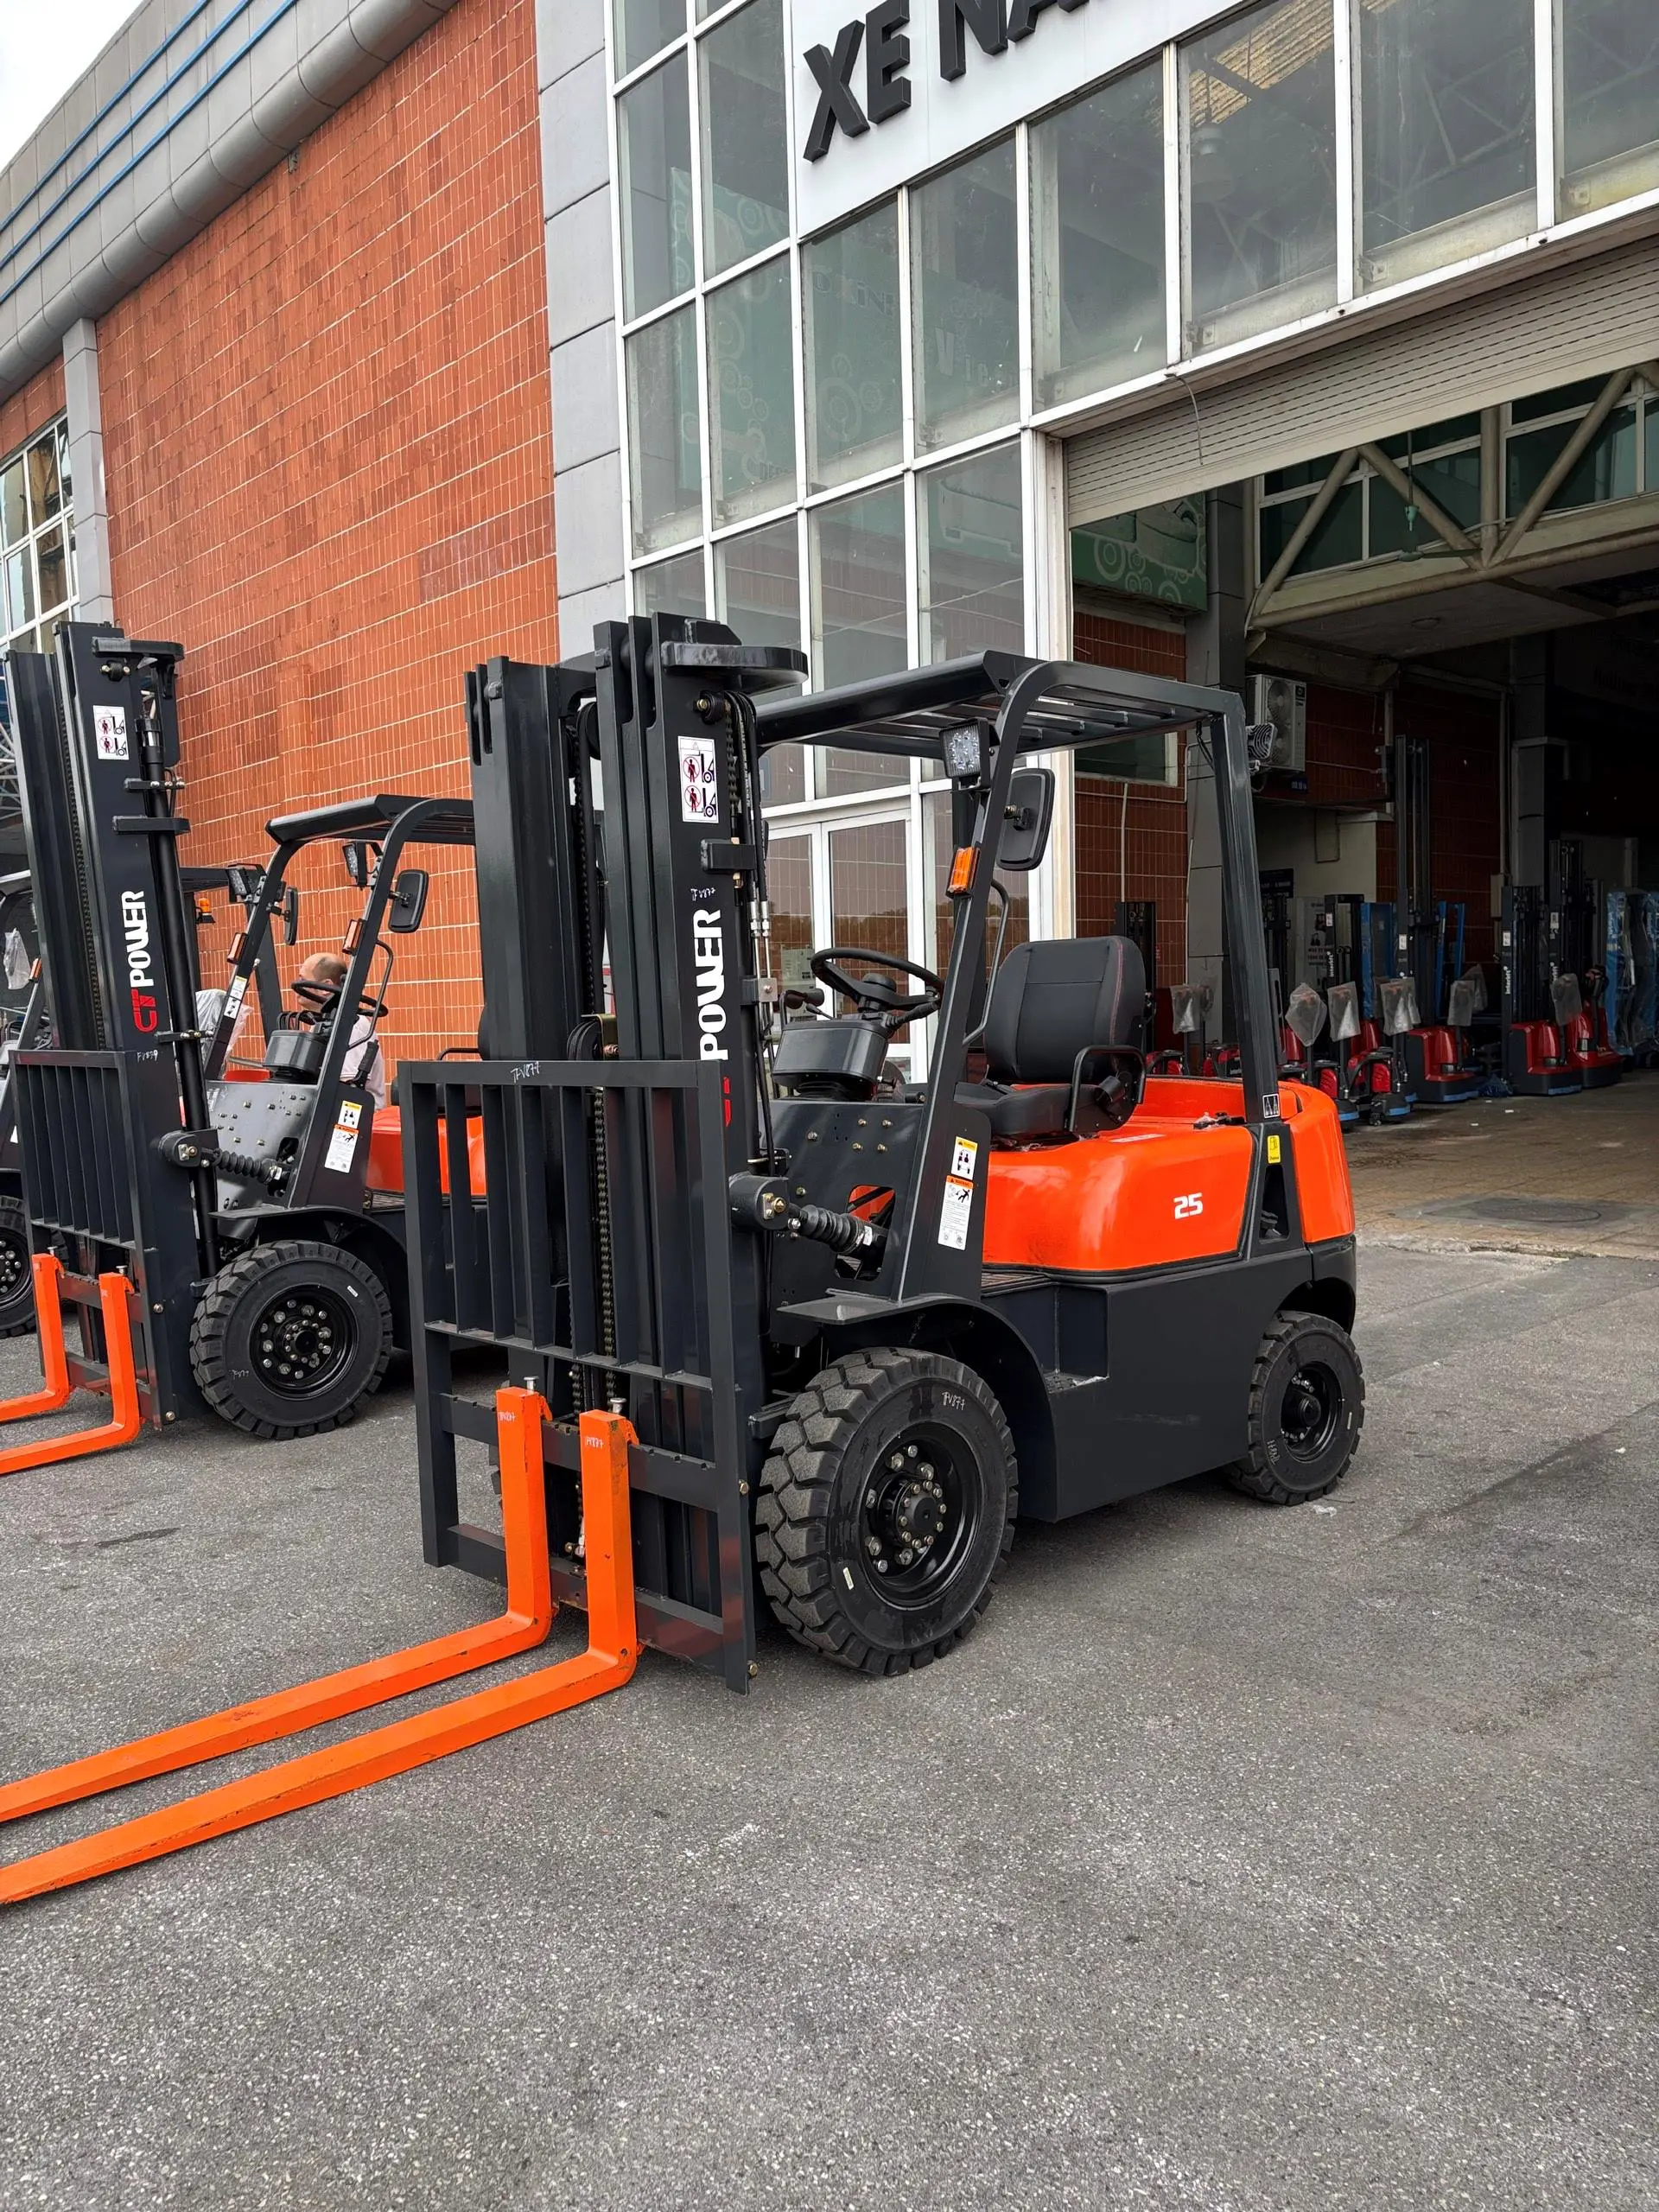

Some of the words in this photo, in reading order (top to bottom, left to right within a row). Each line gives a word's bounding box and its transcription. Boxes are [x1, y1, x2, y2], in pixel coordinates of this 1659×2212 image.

[803, 0, 912, 162] XE
[121, 890, 155, 988] POWER
[693, 909, 728, 1061] POWER
[1173, 1192, 1203, 1219] 25
